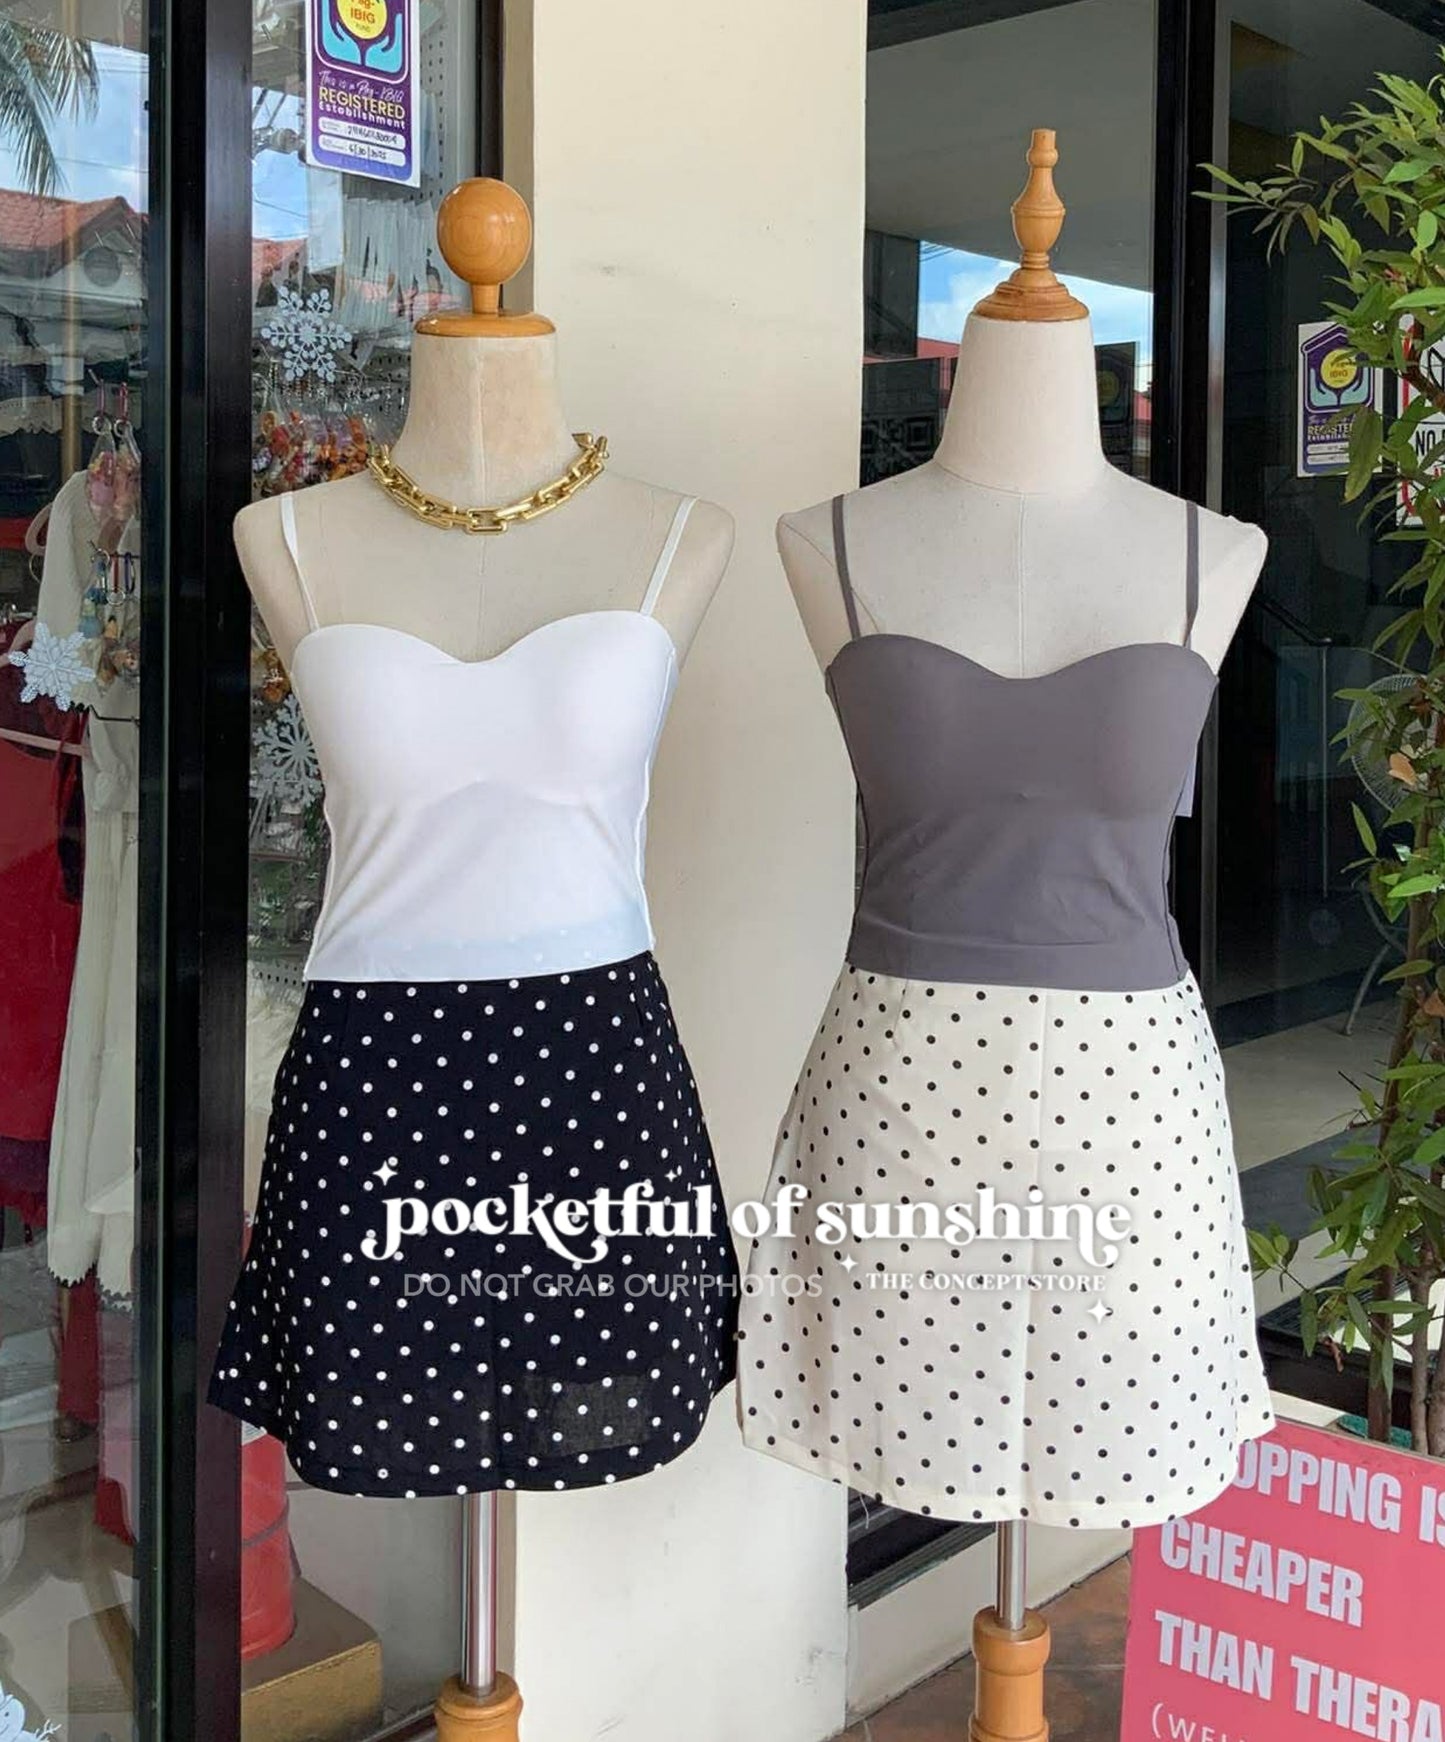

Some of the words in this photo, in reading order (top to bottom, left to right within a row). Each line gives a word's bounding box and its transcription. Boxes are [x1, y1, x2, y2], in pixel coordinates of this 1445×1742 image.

[350, 7, 375, 24] IBIG
[319, 70, 336, 86] This
[318, 101, 406, 129] Establishment
[319, 86, 406, 120] REGISTERED
[1415, 430, 1436, 456] NO
[1160, 1517, 1364, 1628] CHEAPER
[1154, 1609, 1275, 1701] THAN
